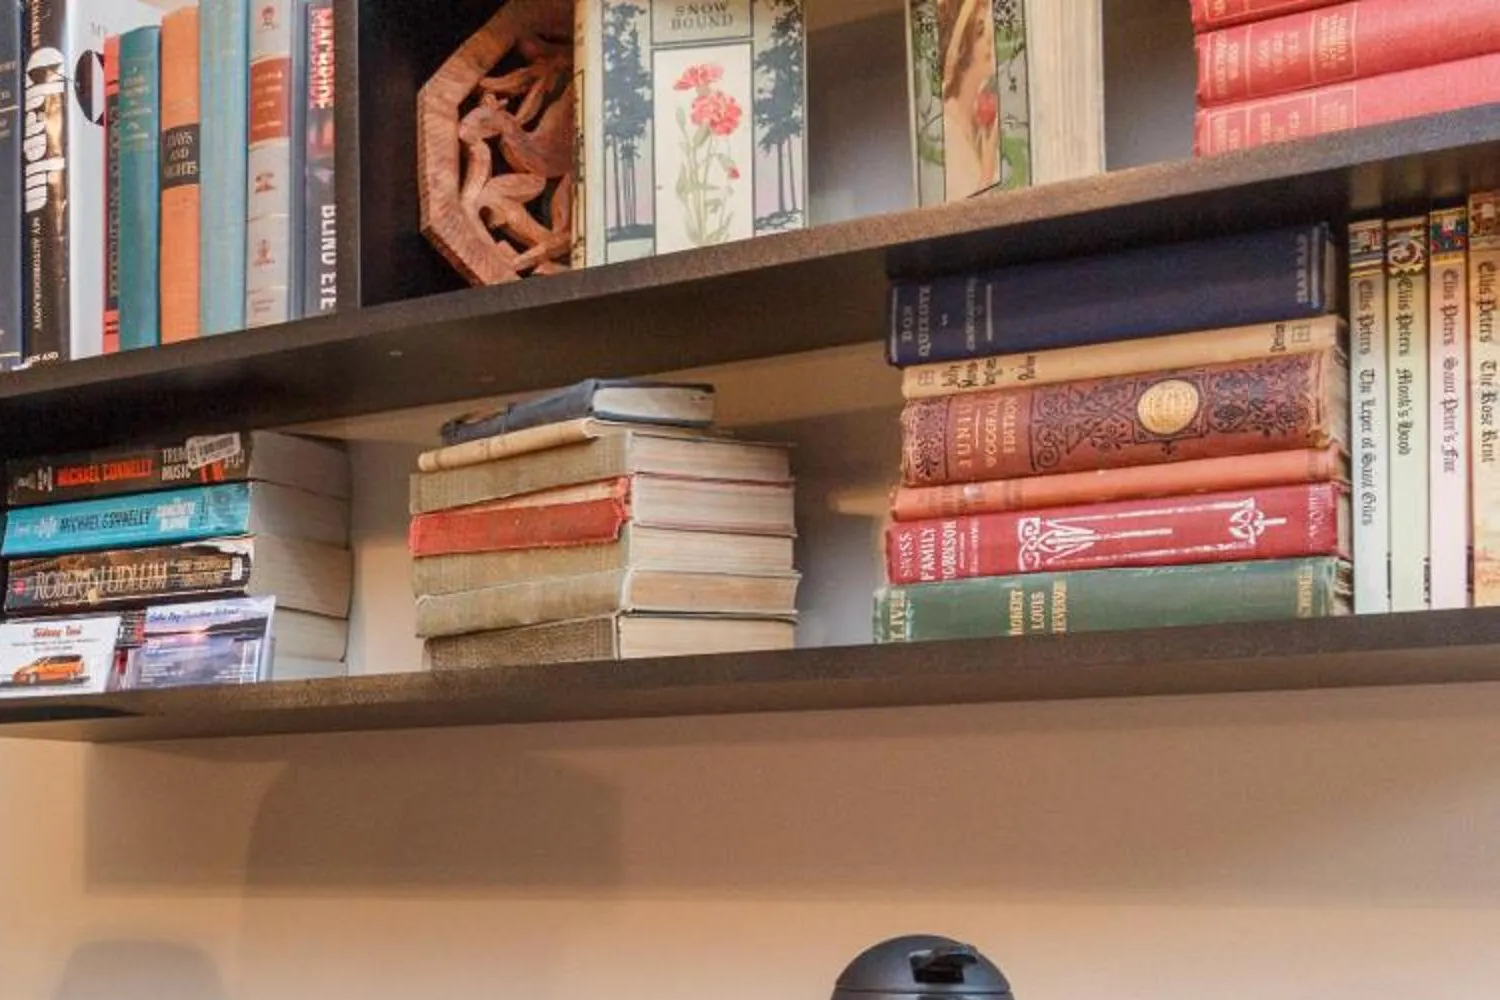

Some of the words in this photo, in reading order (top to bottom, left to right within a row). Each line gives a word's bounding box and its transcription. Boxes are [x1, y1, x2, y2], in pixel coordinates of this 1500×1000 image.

[675, 1, 727, 17] SNOW
[24, 47, 65, 214] Chaplin
[320, 204, 337, 266] BLIND
[320, 271, 337, 311] EYE
[1396, 313, 1414, 357] Peters
[1440, 304, 1459, 347] Peters
[1476, 297, 1496, 344] Peters
[1480, 360, 1498, 387] The
[1480, 390, 1498, 426] Rose
[1481, 429, 1498, 464] Rent
[56, 463, 101, 487] MICHAEL
[102, 458, 153, 481] CONNELLY
[101, 506, 151, 529] CONNELLY
[920, 527, 936, 581] FAMILY
[1030, 591, 1045, 630] LOUIS
